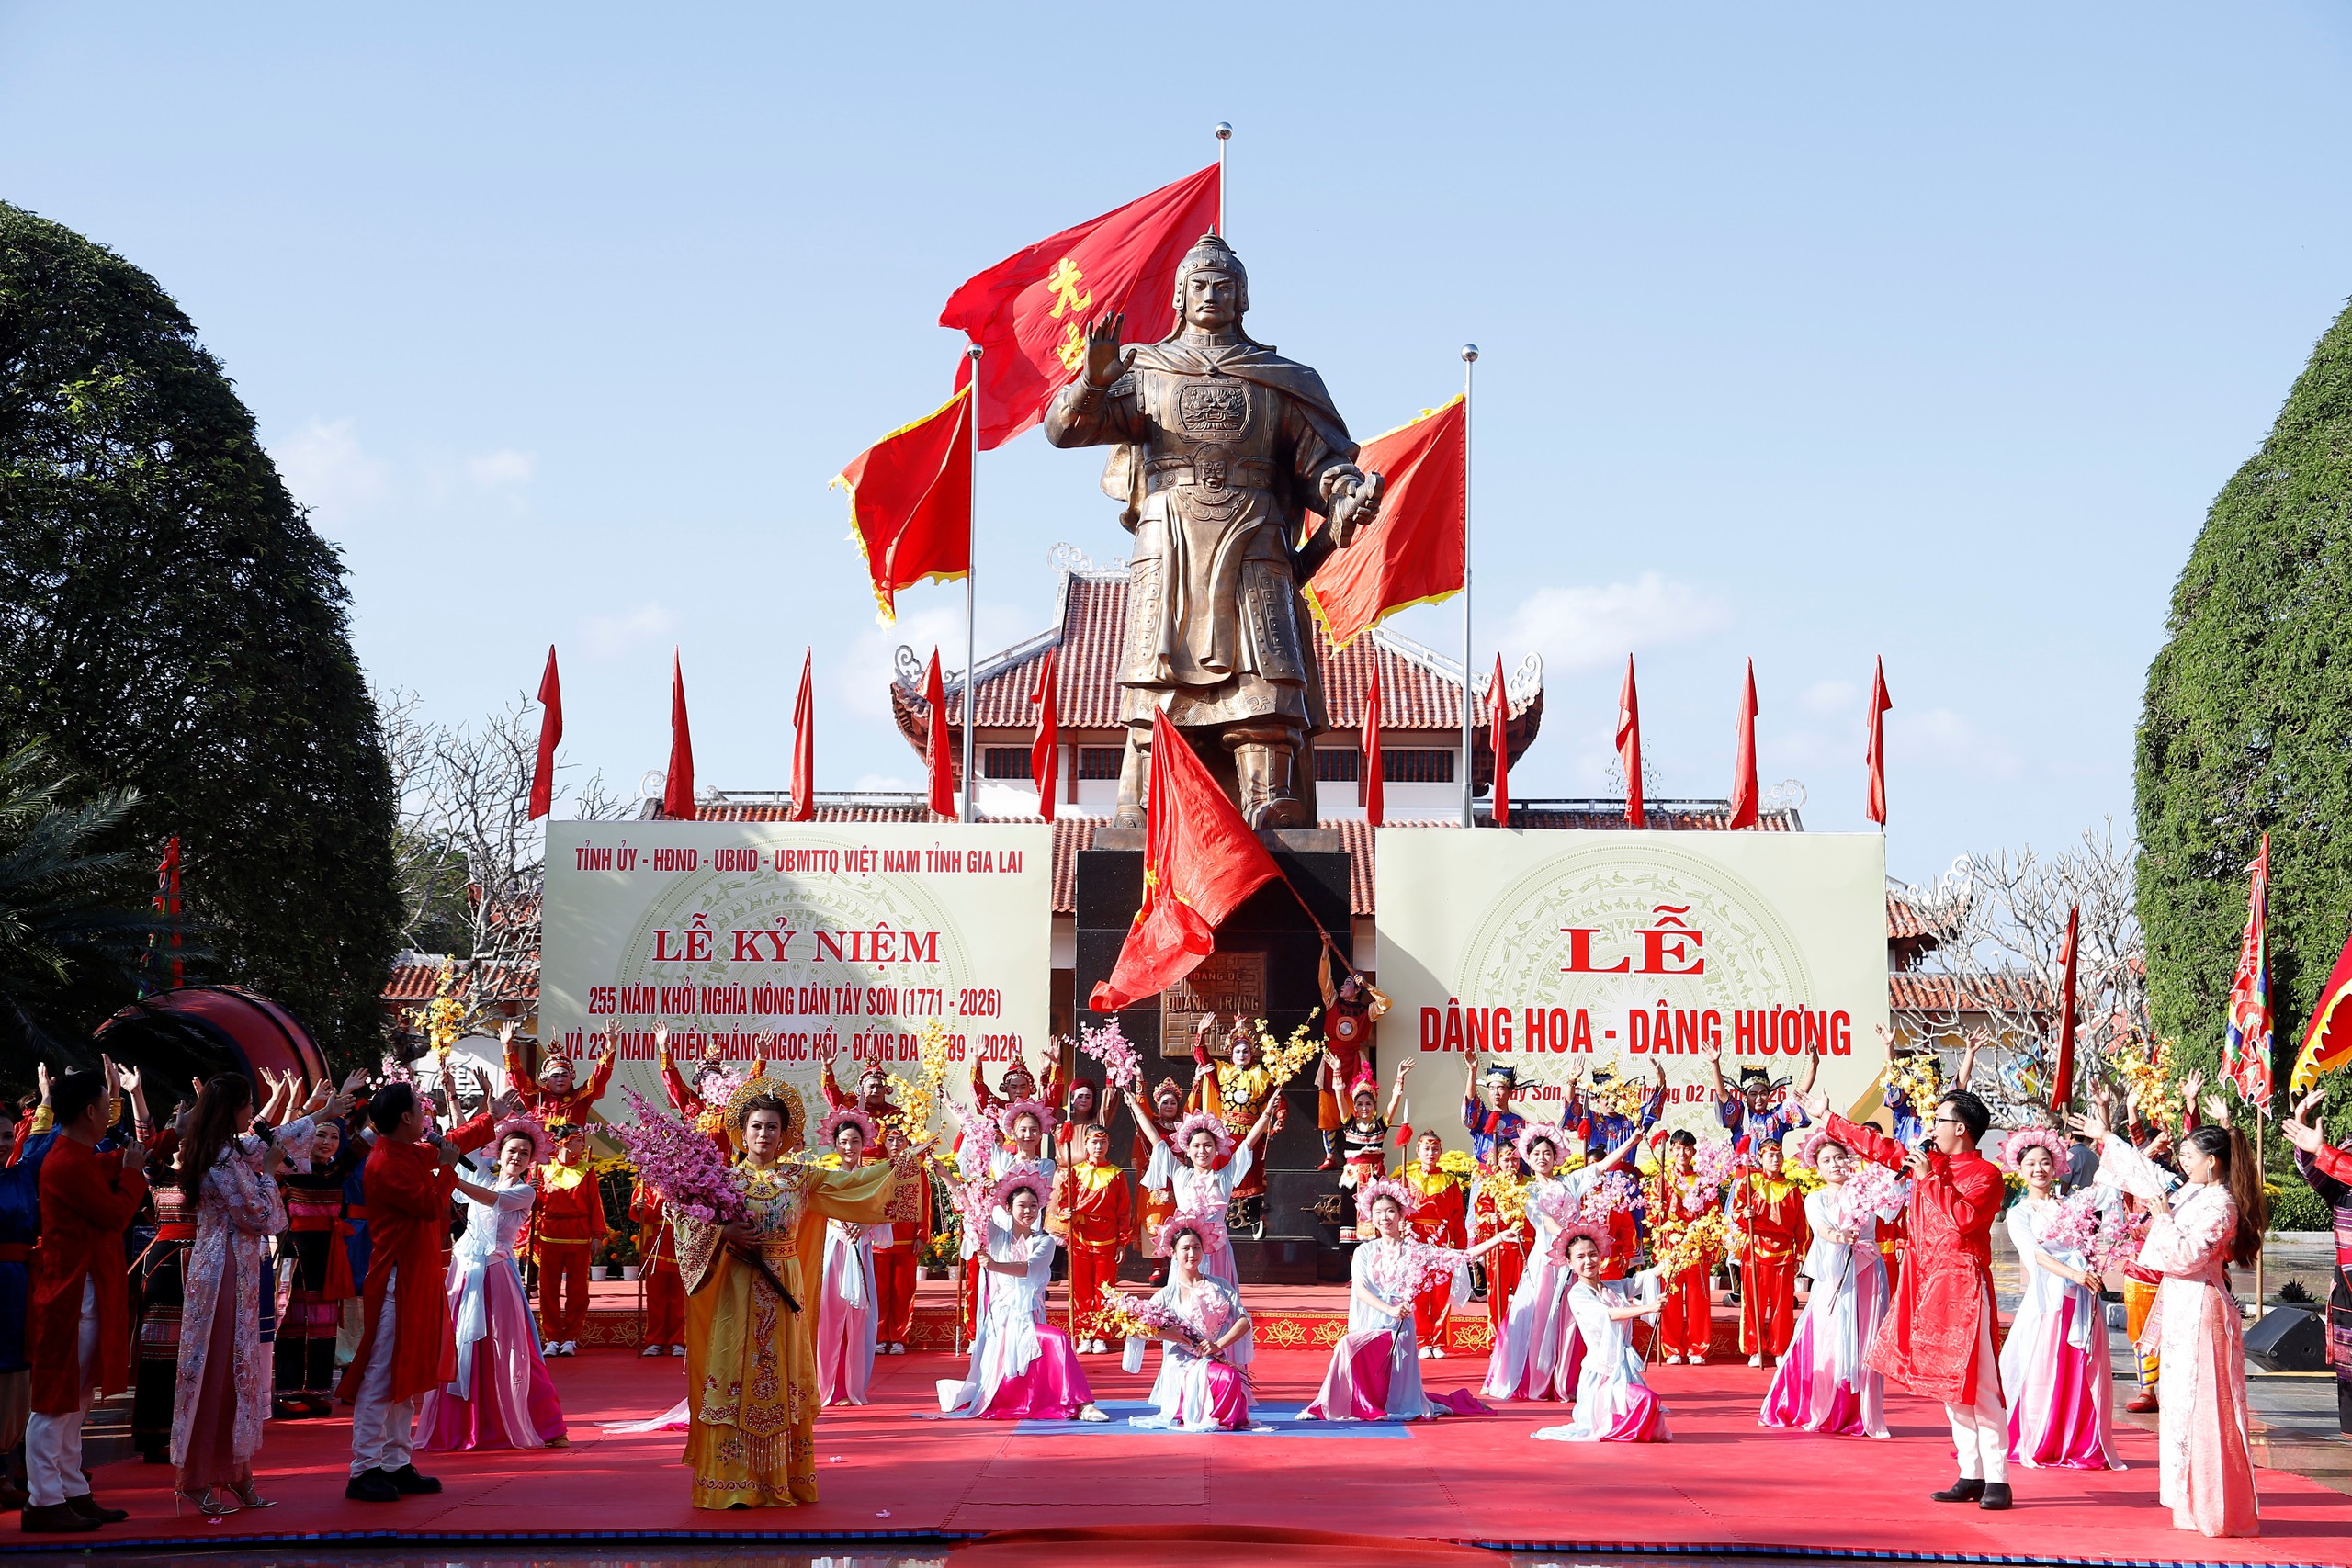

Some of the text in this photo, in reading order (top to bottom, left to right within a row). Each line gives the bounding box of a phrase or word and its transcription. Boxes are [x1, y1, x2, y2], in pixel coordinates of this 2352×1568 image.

[575, 839, 613, 871] TỈNH
[616, 839, 638, 871] ỦY
[653, 849, 698, 872] HĐND
[714, 849, 758, 872] UBND
[775, 849, 839, 874] UBMTTQ
[843, 845, 878, 877] VIỆT
[883, 850, 920, 873] NAM
[925, 841, 962, 873] TỈNH
[967, 851, 994, 874] GIA
[999, 851, 1023, 874] LAI
[651, 912, 941, 971] LỄ KỶ NIỆM
[1560, 905, 1704, 975] LỄ
[588, 987, 616, 1015] 255
[620, 981, 655, 1015] NĂM
[661, 976, 696, 1015] KHỞI
[701, 982, 747, 1015] NGHĨA
[752, 981, 795, 1015] NÔNG
[799, 982, 831, 1015] DÂN
[835, 982, 862, 1015] TÂY
[866, 984, 898, 1016] SƠN
[903, 988, 943, 1019] (1771
[959, 989, 1001, 1019] 2026)
[565, 1027, 583, 1060] VÀ
[588, 1032, 611, 1060] 23
[620, 1028, 655, 1060] NĂM
[663, 1024, 707, 1060] HIẾN
[899, 1033, 919, 1062] ĐA
[1419, 997, 1851, 1055] DÂNG HOA - DÂNG HƯƠNG
[1685, 1084, 1705, 1102] 02
